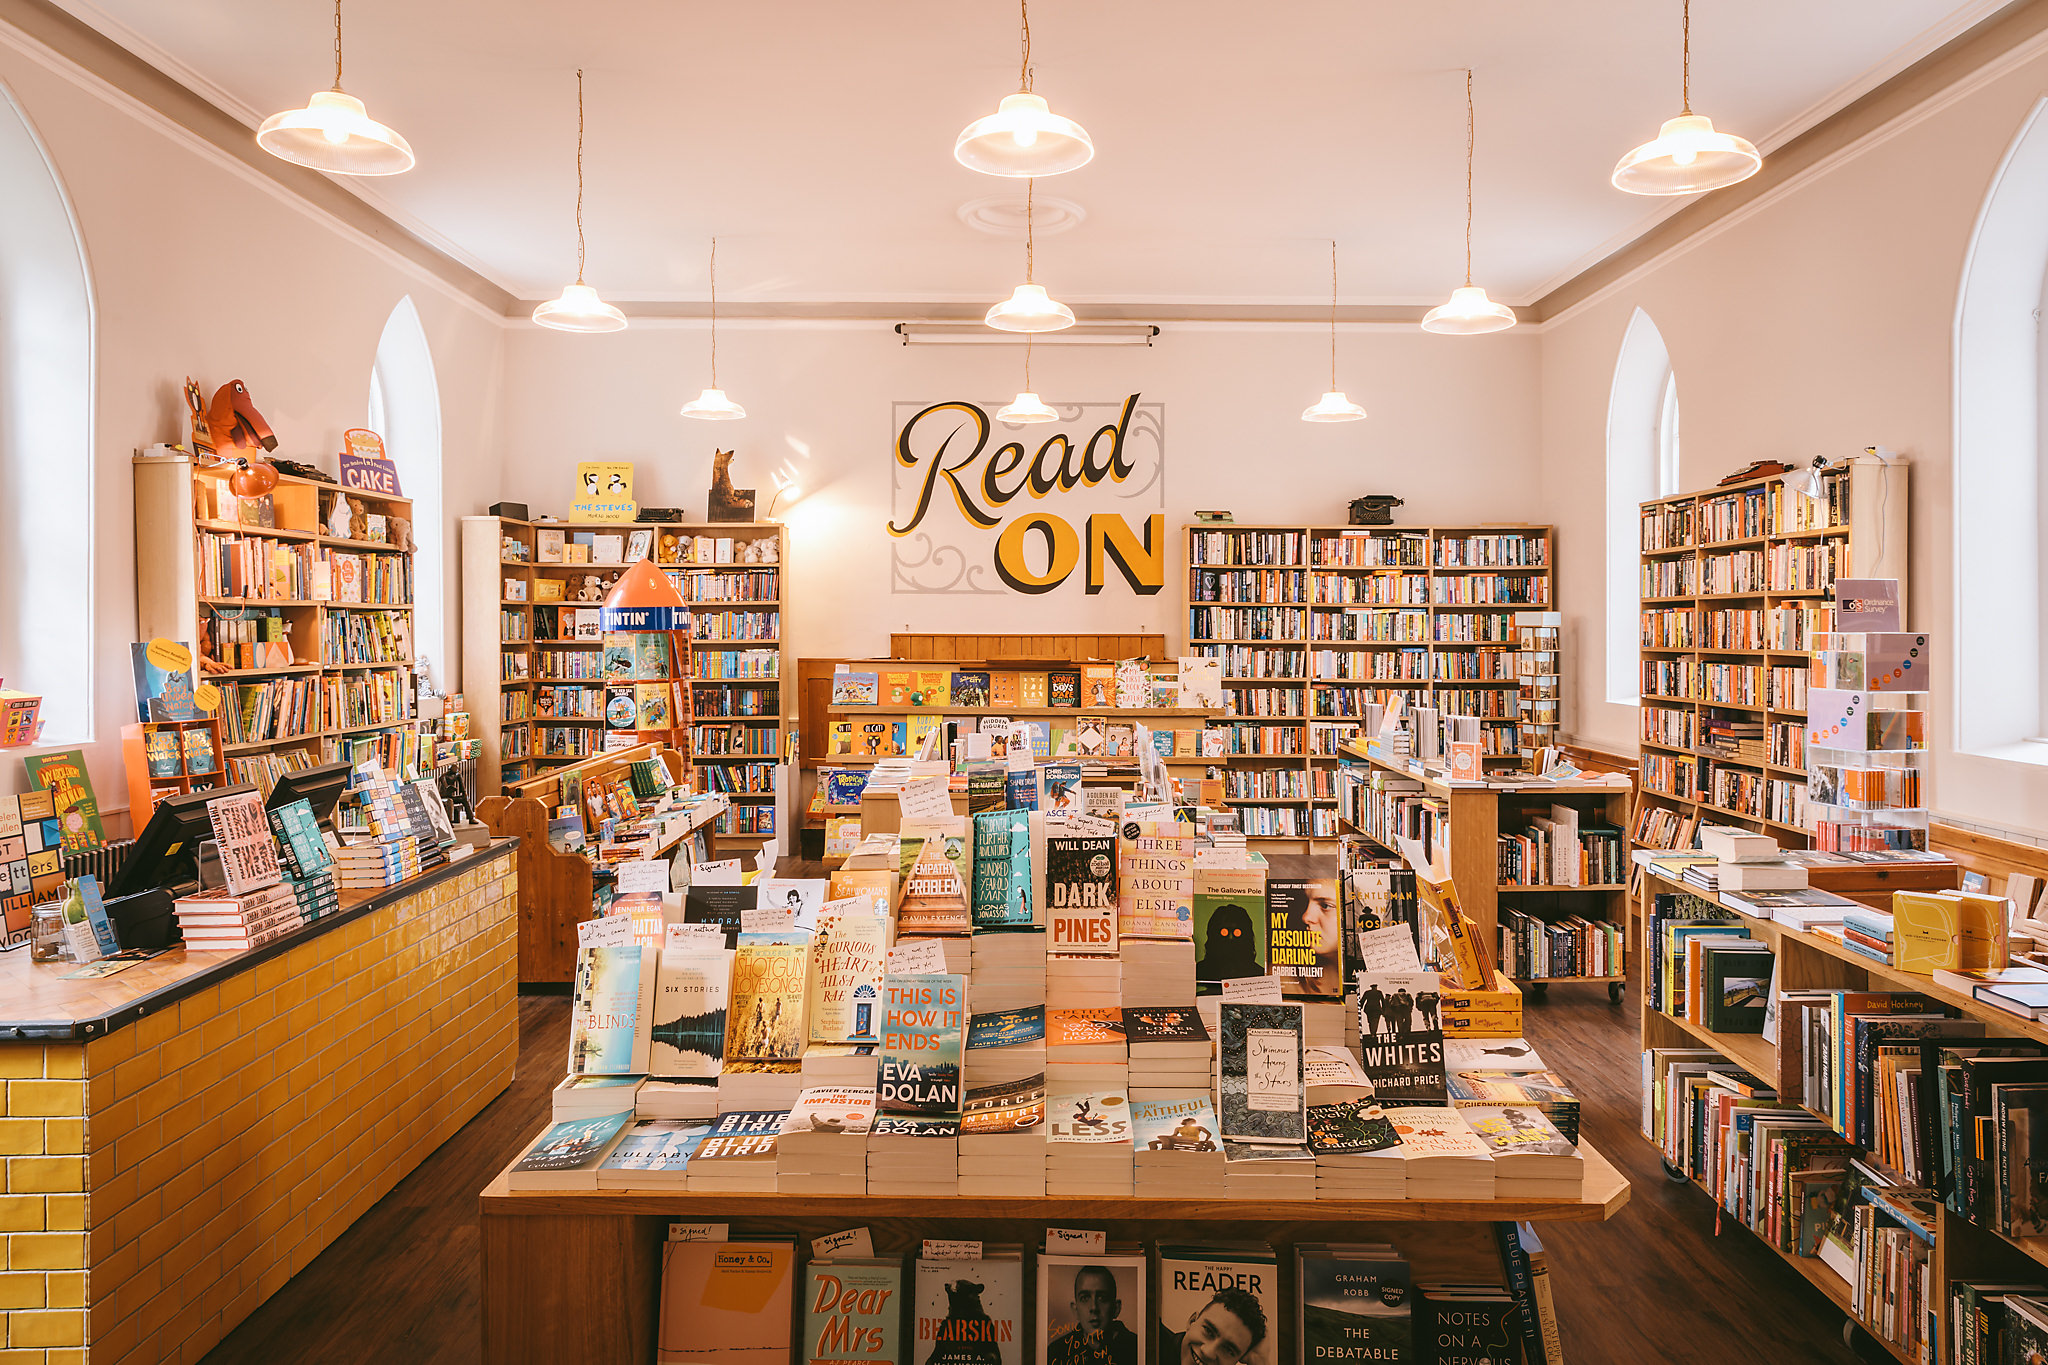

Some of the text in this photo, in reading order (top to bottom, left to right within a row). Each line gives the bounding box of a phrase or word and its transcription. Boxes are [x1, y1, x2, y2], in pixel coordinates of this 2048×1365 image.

[886, 392, 1141, 537] Read
[347, 468, 393, 494] CAKE
[994, 512, 1165, 595] ON
[605, 612, 645, 625] TINTIN
[1052, 676, 1075, 684] STORIES
[1053, 684, 1074, 692] BOYS
[58, 779, 71, 792] IS A
[0, 814, 17, 822] elen
[0, 824, 19, 832] ullen
[1055, 840, 1110, 850] WILL DEAN
[1135, 839, 1182, 850] THREE
[930, 852, 941, 860] THE
[915, 863, 955, 875] EMPATHY
[1129, 858, 1186, 871] THINGS
[907, 879, 960, 895] PROBLEM
[1132, 880, 1182, 891] ABOUT
[980, 891, 1008, 901] MAN
[1054, 882, 1110, 907] DARK
[1350, 892, 1413, 900] GENTLEMAN
[615, 906, 644, 914] JENNIFER
[1137, 900, 1176, 911] ELSIE
[978, 910, 1010, 918] JONASSON
[1271, 913, 1288, 929] MY
[1054, 918, 1111, 942] PINES
[1271, 930, 1322, 947] ABSOLUTE
[829, 942, 876, 956] CURIOUS
[1272, 949, 1316, 965] DARLING
[737, 956, 804, 978] SHOTGUN
[1272, 966, 1323, 978] GABRIEL TALLENT
[735, 978, 802, 993] LOVESONGS
[820, 975, 855, 988] AILSA
[824, 990, 846, 1003] RAE
[888, 988, 956, 1004] THIS IS
[1867, 1000, 1923, 1010] David Hockney
[888, 1010, 960, 1027] HOW IT
[977, 1015, 1038, 1028] ISLANDER
[886, 1034, 940, 1050] ENDS
[1377, 1035, 1397, 1044] THE
[1366, 1043, 1441, 1067] WHITES
[883, 1064, 922, 1082] EVA
[1821, 1064, 1829, 1088] HADID
[1374, 1075, 1440, 1088] RICHARD PRICE
[882, 1084, 956, 1103] DOLAN
[971, 1091, 1038, 1109] FORCE
[1898, 1081, 1906, 1115] ANDREW
[967, 1107, 1039, 1122] NATURE
[1134, 1100, 1208, 1119] FAITHFUL
[2000, 1101, 2008, 1127] ANDREW
[724, 1113, 789, 1124] BLUE
[1472, 1118, 1508, 1128] LET
[1052, 1121, 1127, 1136] LESS
[1308, 1124, 1340, 1132] Life
[1482, 1126, 1512, 1134] GO
[707, 1135, 775, 1148] BLUE
[1315, 1138, 1379, 1149] Garden
[1493, 1134, 1550, 1146] HAND
[612, 1151, 692, 1159] LULLABY
[700, 1145, 772, 1158] BIRD
[528, 1161, 564, 1169] Celeste
[1873, 1197, 1908, 1225] PEOPLE
[718, 1256, 745, 1264] Honey
[757, 1256, 770, 1264] Co.
[1174, 1271, 1263, 1294] READER
[1336, 1275, 1377, 1283] GRAHAM
[813, 1274, 892, 1315] Dear
[1344, 1289, 1369, 1297] ROBB
[1381, 1287, 1403, 1295] SIGNED
[1438, 1313, 1490, 1326] NOTES
[919, 1318, 1012, 1342] BEARSKIN
[1965, 1311, 1974, 1342] BOOK
[816, 1315, 883, 1358] Mrs
[1344, 1328, 1370, 1339] THE
[1438, 1334, 1481, 1348] ON A
[1316, 1346, 1399, 1360] DEBATABLE
